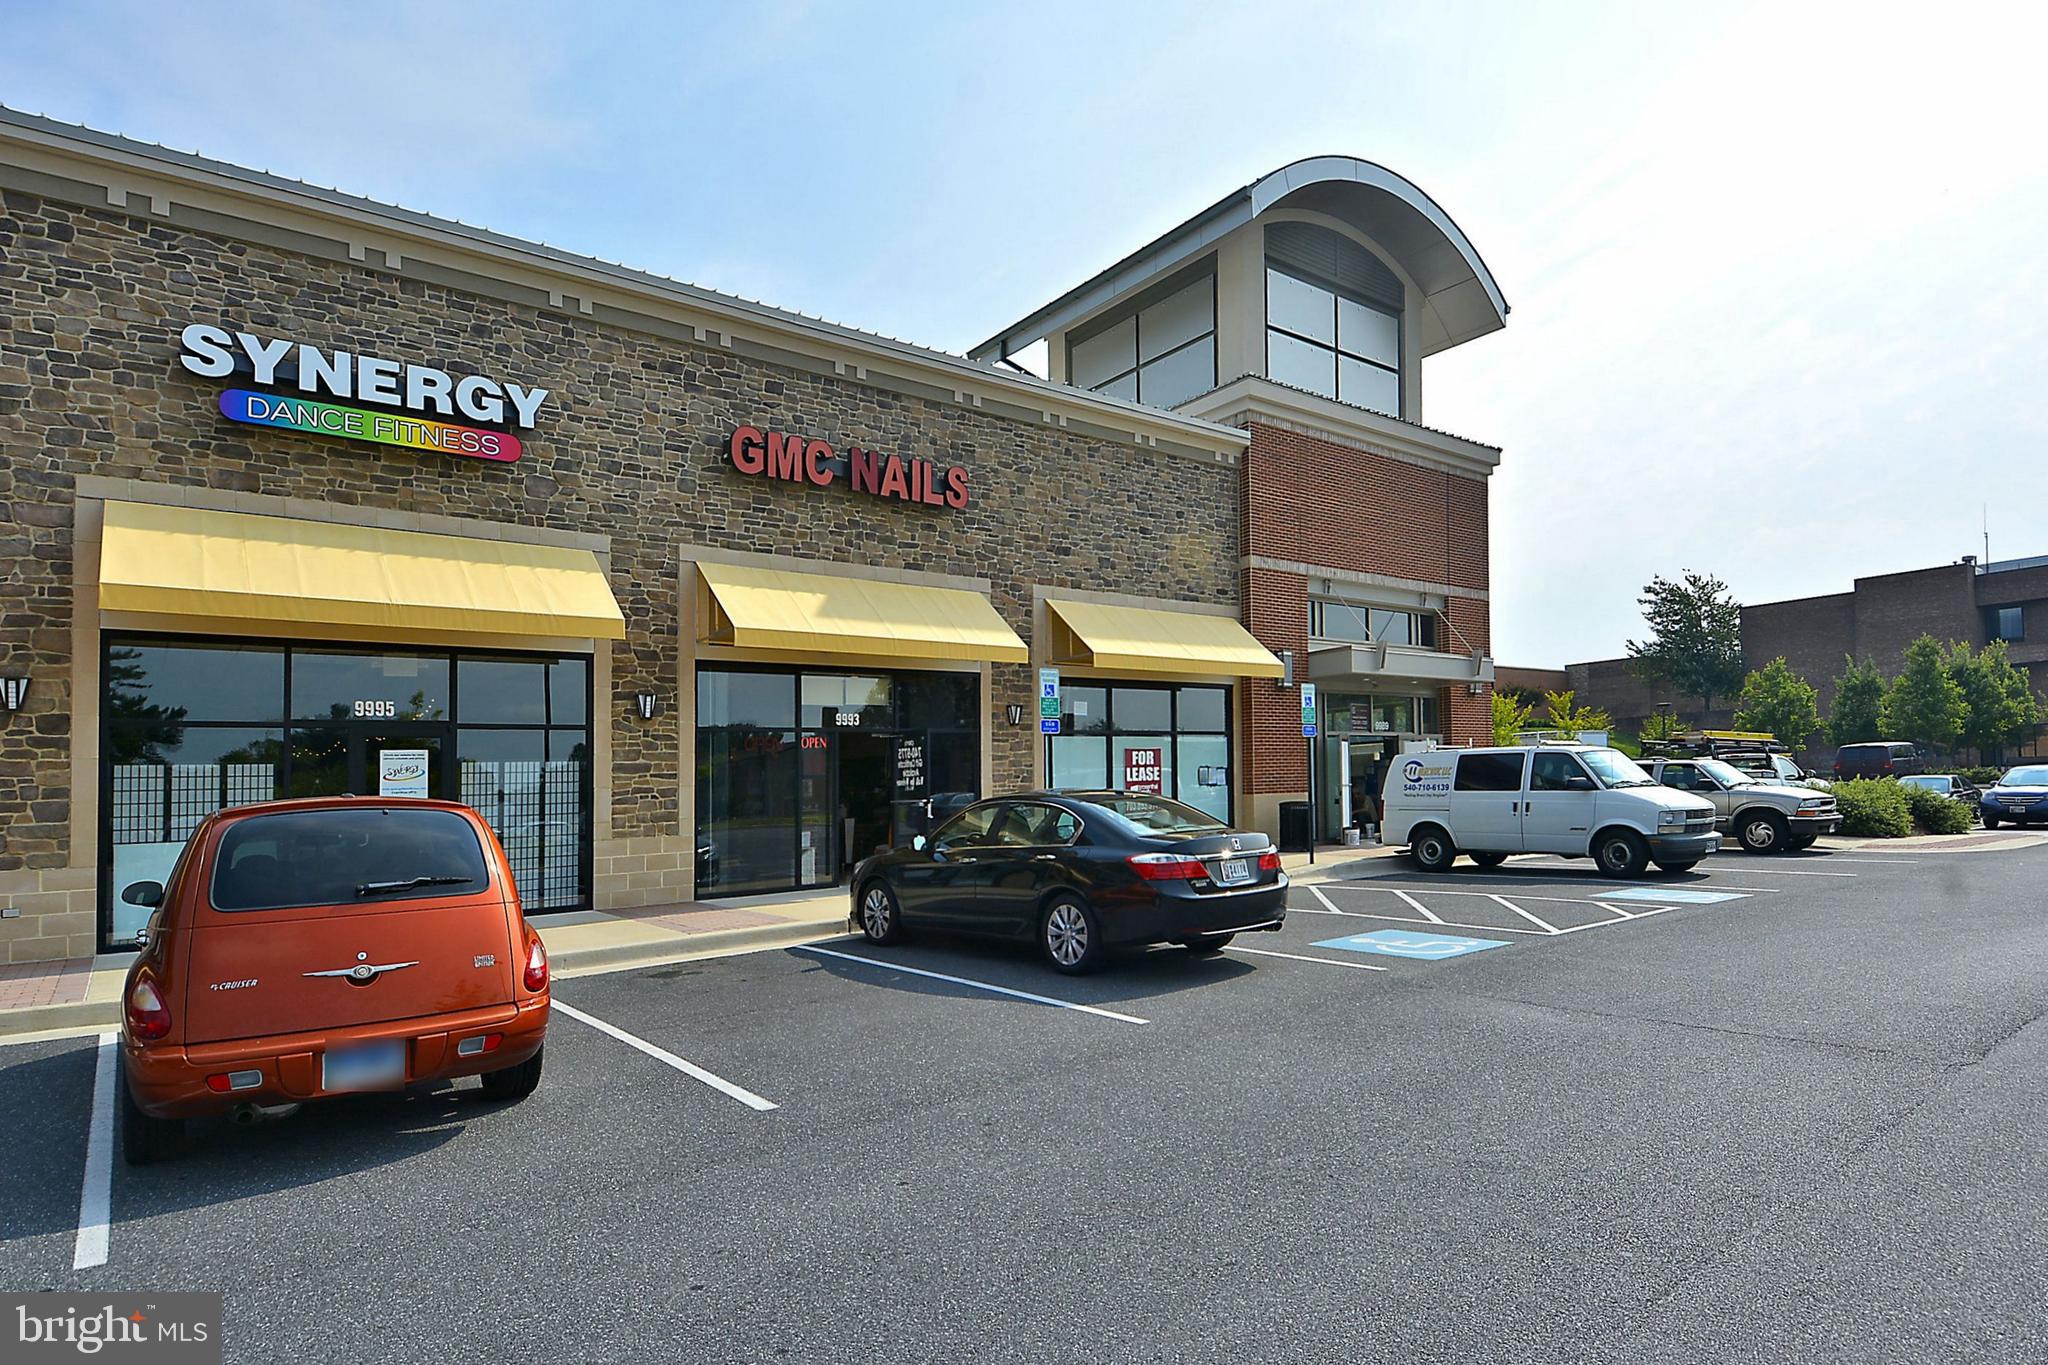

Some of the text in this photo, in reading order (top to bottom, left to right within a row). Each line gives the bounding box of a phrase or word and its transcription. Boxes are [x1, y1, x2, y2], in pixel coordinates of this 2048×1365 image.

[180, 324, 548, 429] SYNERGY
[246, 395, 501, 457] DANCE FITNESS
[730, 425, 970, 509] GMC NAILS
[354, 700, 395, 717] 9995
[835, 713, 860, 726] 9993
[801, 737, 827, 748] OPEN
[1132, 751, 1155, 765] FOR
[1126, 767, 1160, 781] LEASE
[1403, 783, 1450, 791] 540-710-6139
[219, 979, 258, 990] CRUISER
